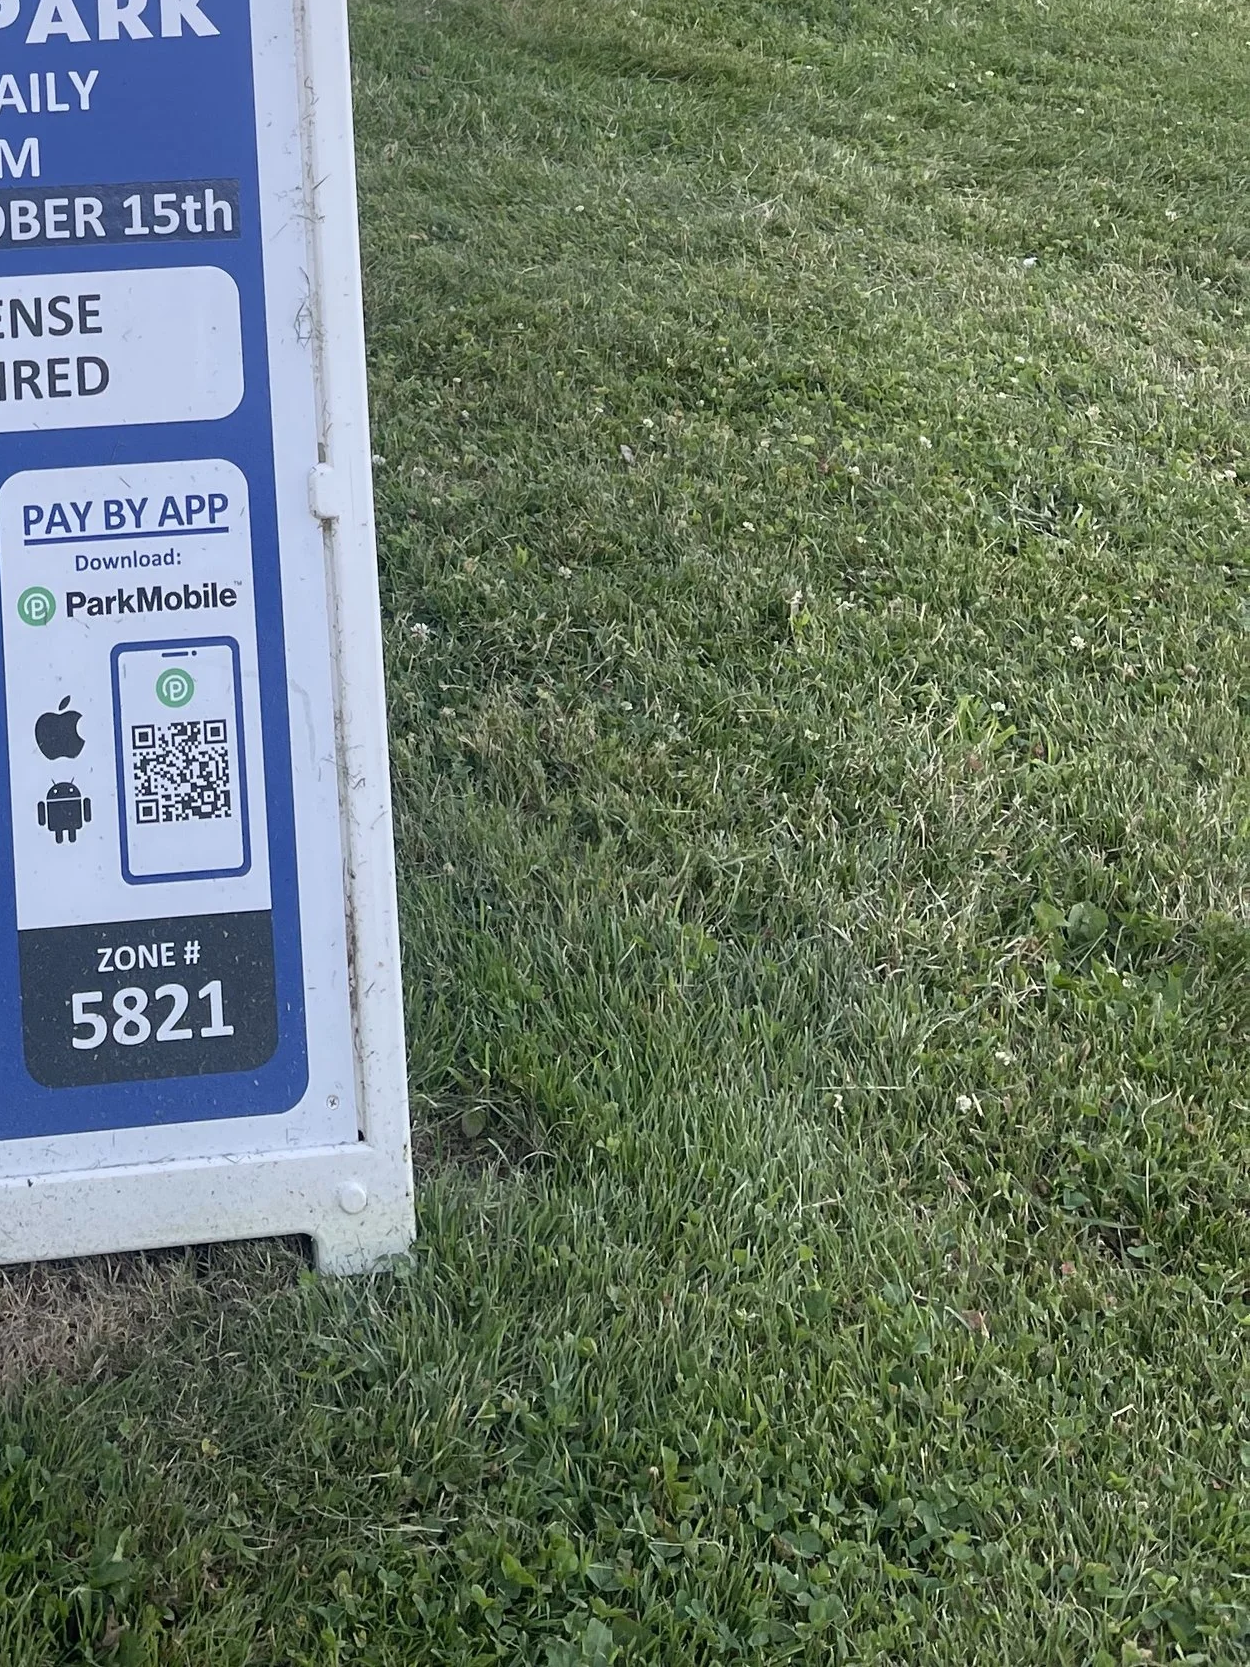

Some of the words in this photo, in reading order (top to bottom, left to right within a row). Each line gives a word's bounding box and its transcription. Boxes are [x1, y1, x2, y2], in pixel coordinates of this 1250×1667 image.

[123, 189, 234, 237] 15th
[23, 501, 93, 535] PAY
[103, 497, 148, 530] BY
[158, 493, 228, 527] APP
[75, 548, 181, 571] Download:
[97, 941, 176, 971] ZONE
[183, 940, 201, 965] #
[71, 979, 235, 1051] 5821
